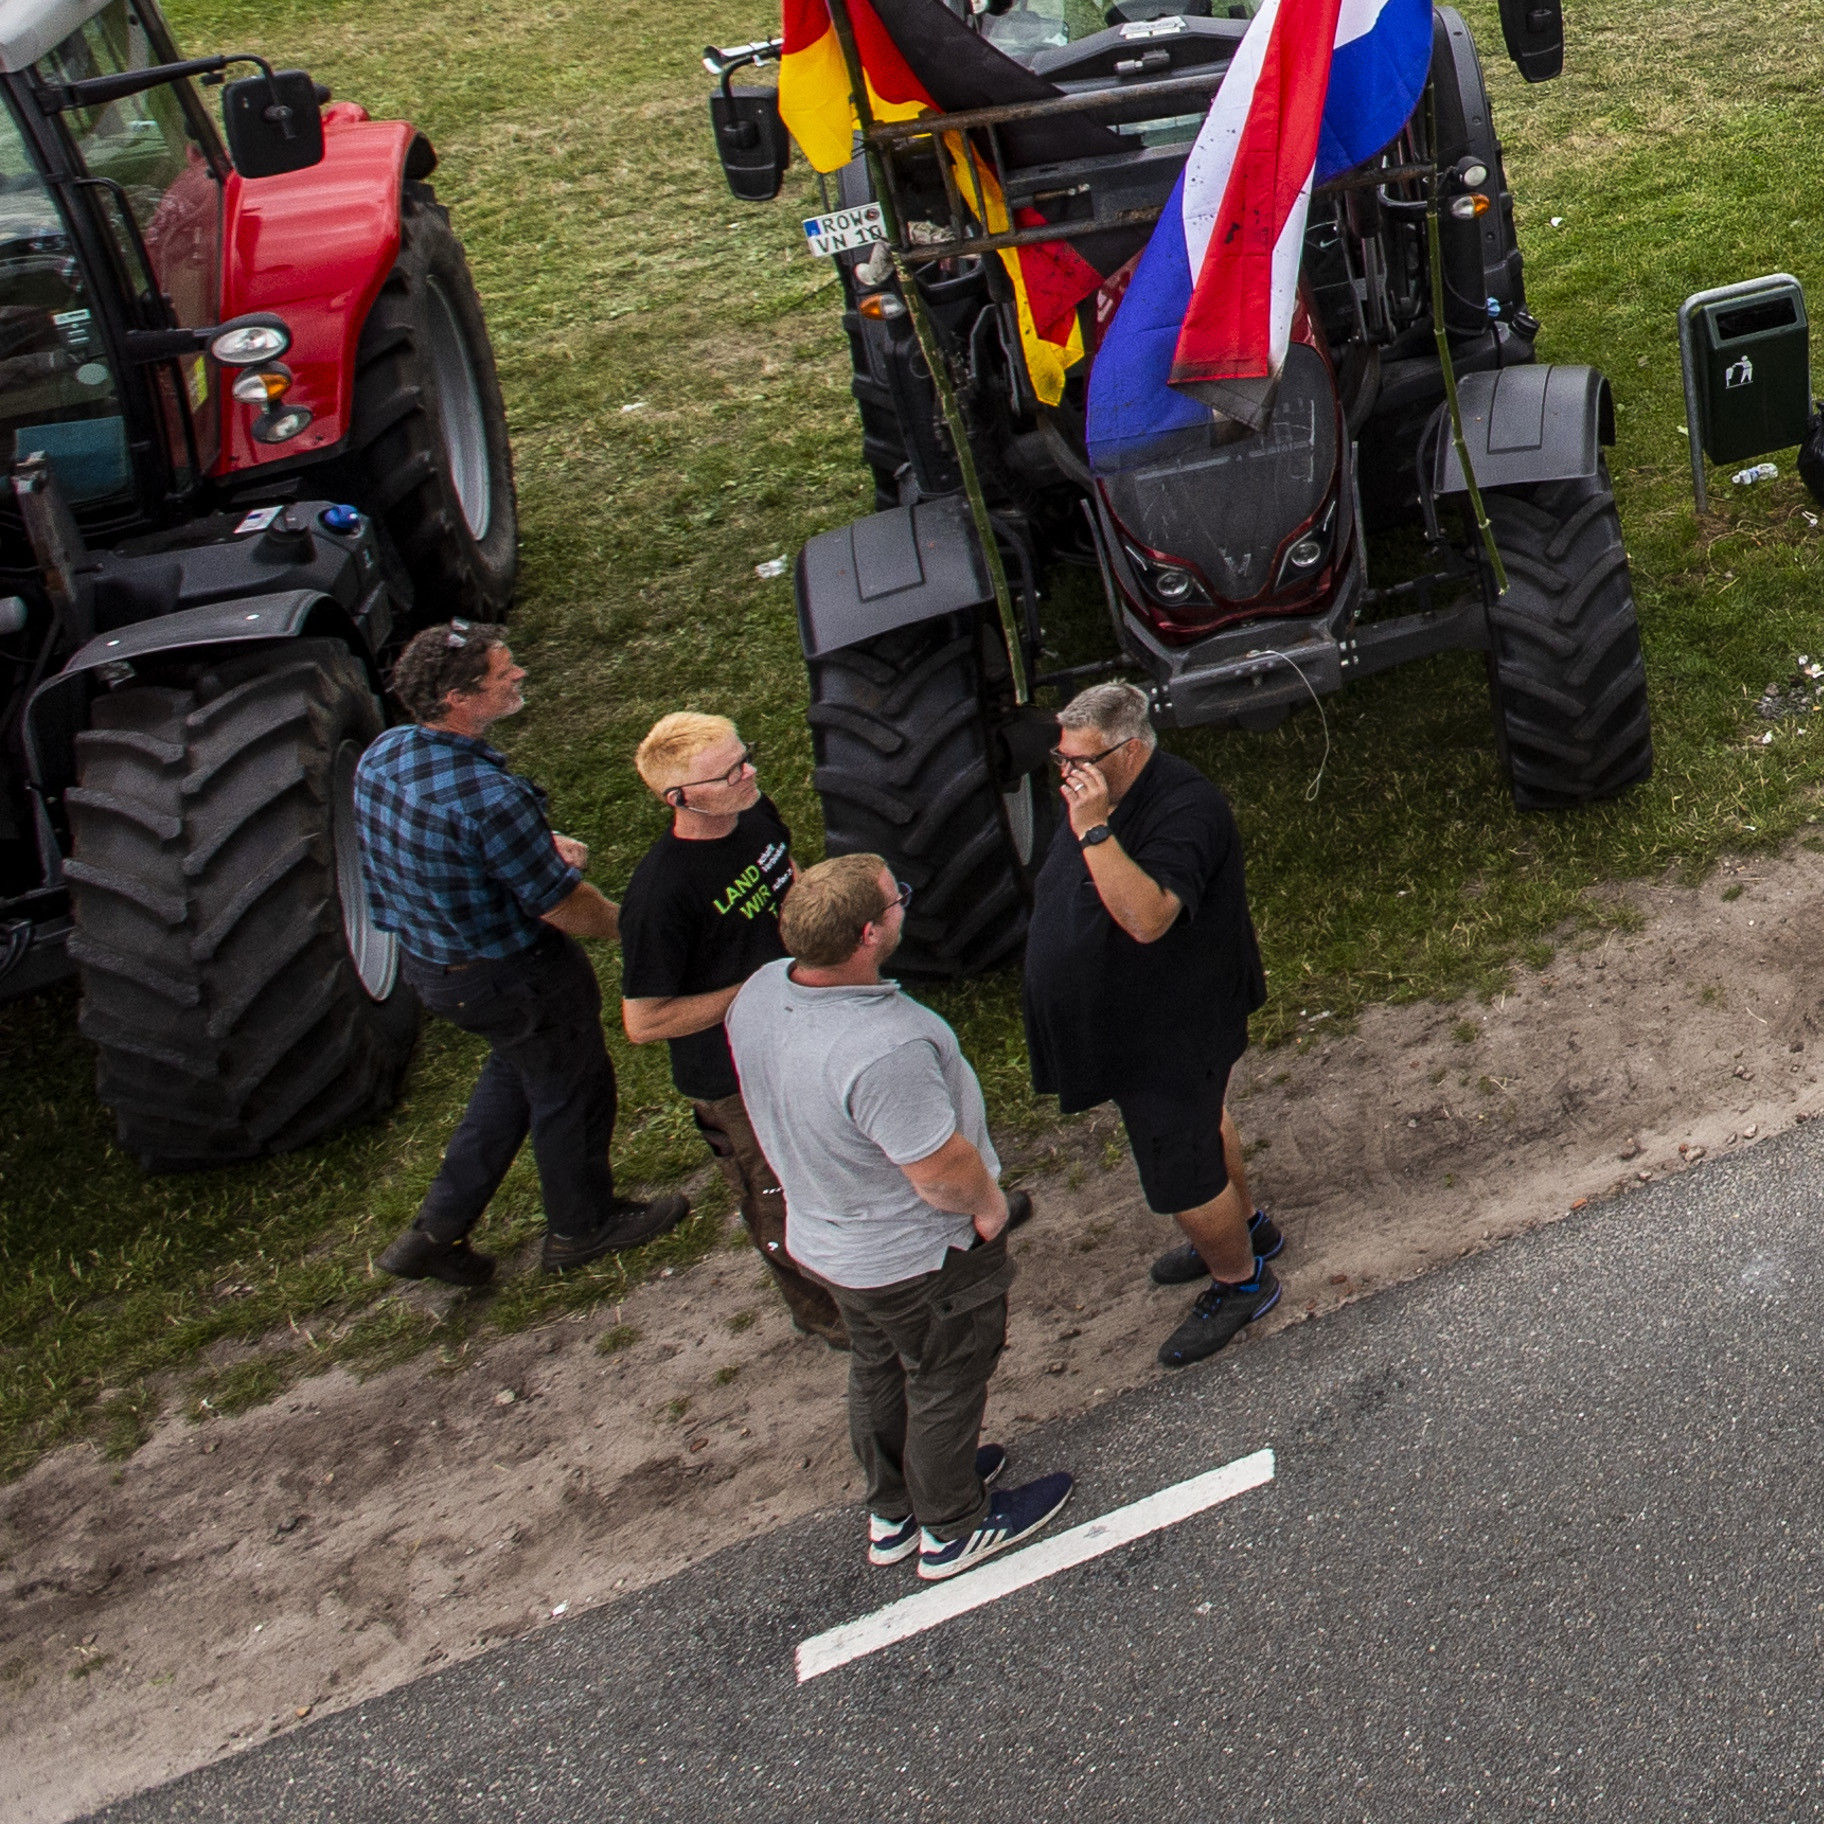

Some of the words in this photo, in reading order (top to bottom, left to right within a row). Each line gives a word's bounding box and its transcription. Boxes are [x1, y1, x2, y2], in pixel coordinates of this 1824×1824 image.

[822, 209, 864, 234] ROW
[816, 233, 848, 254] VN
[713, 864, 760, 915] LAND
[740, 883, 772, 920] WIR
